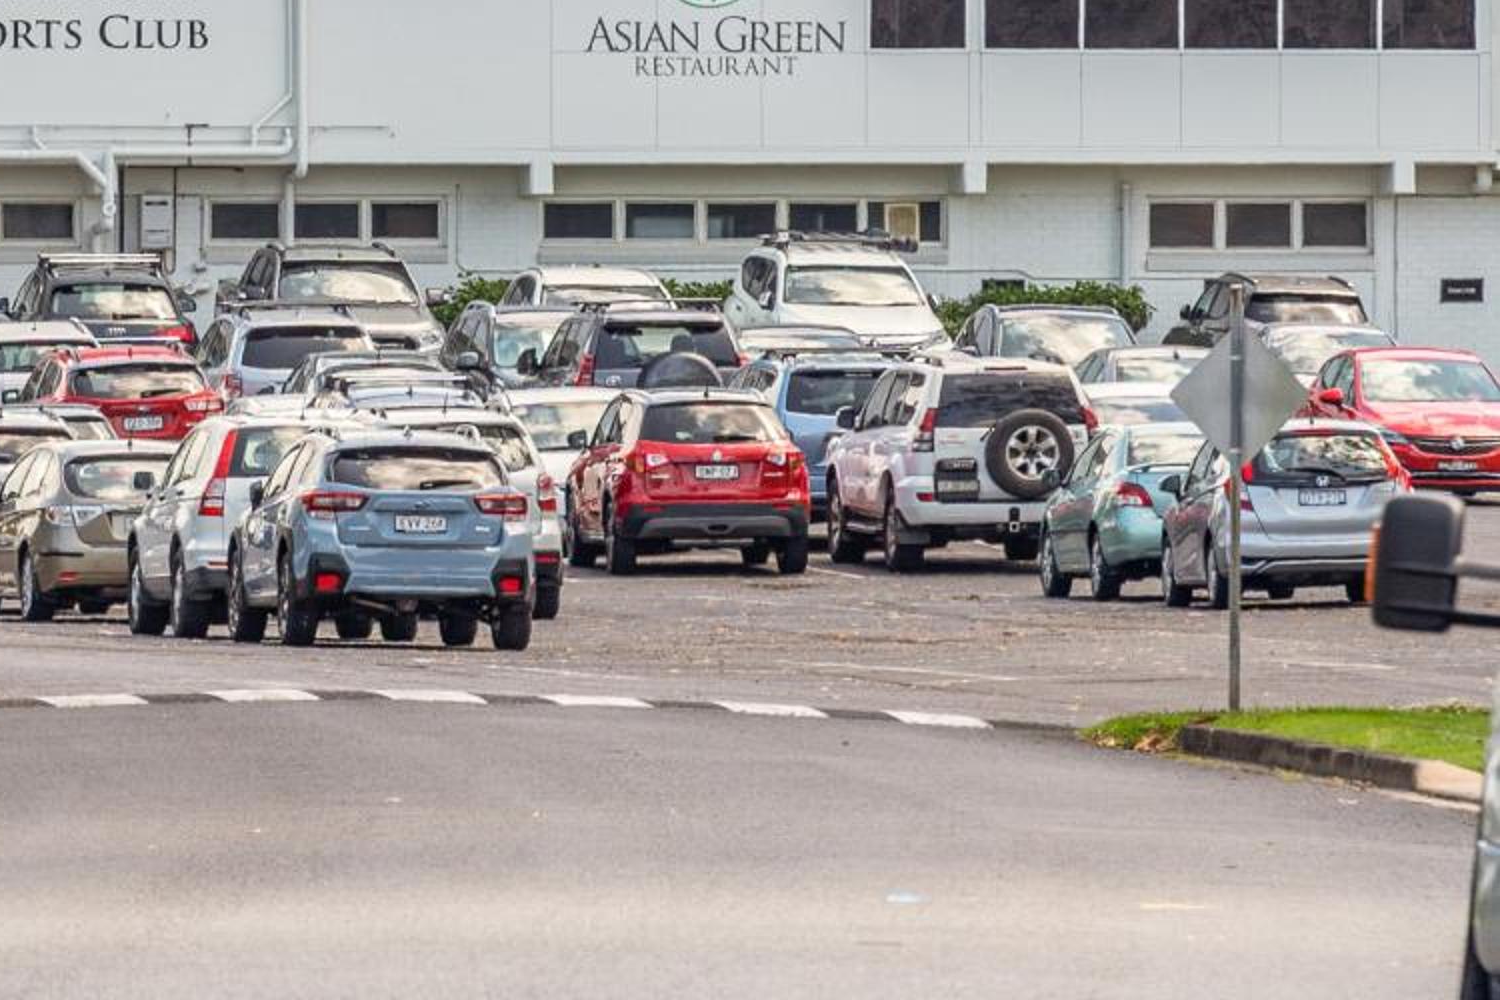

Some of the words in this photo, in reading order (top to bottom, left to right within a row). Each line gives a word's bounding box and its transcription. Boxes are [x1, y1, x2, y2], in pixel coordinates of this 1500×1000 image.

[98, 14, 209, 49] CLUB
[584, 16, 700, 53] ASIAN
[714, 15, 846, 53] GREEN
[634, 56, 798, 77] RESTAURANT
